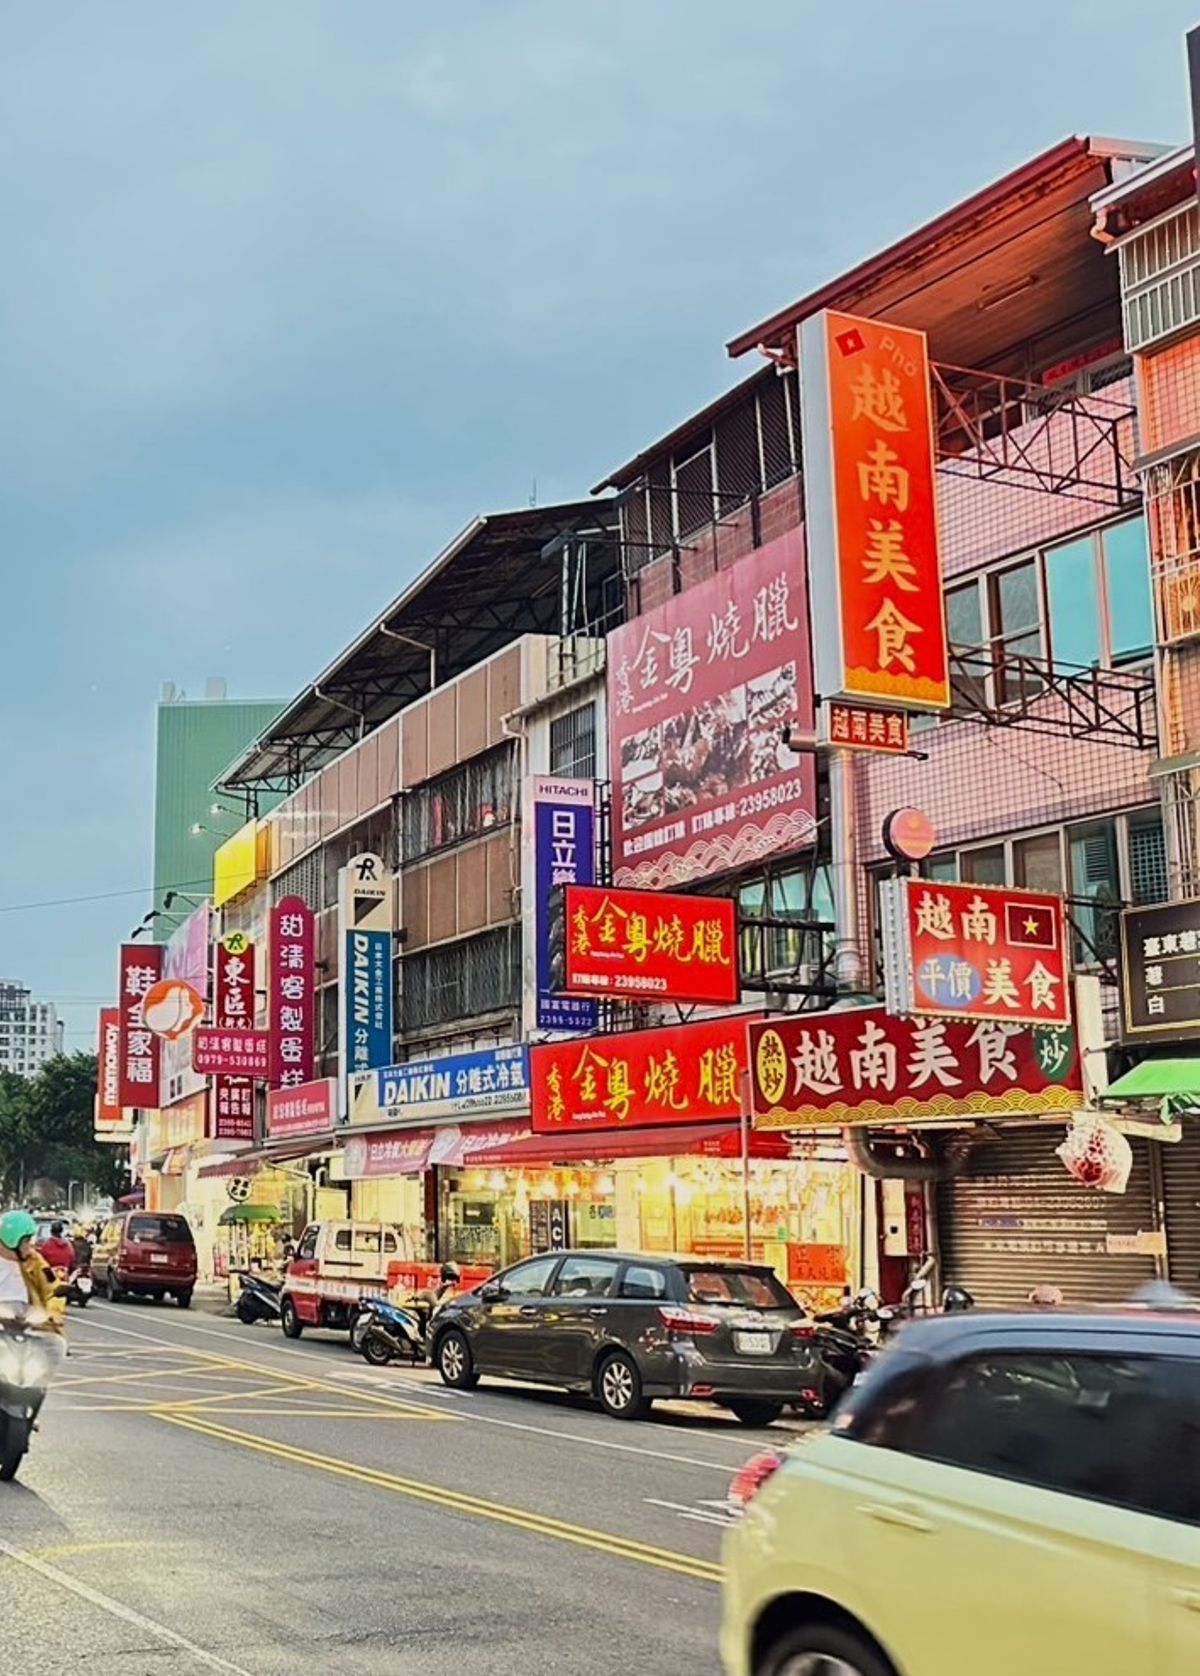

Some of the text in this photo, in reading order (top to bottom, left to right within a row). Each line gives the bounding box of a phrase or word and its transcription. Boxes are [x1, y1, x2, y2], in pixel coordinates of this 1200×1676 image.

[849, 361, 924, 673] 越南美食
[632, 571, 799, 693] 金粵燒臘
[832, 707, 904, 746] 越南美食
[538, 784, 588, 797] HITACHI
[353, 887, 386, 897] DAIKIN
[914, 890, 999, 946] 越南
[590, 895, 730, 965] 金粵燒臘
[223, 959, 251, 1016] 東區
[354, 932, 370, 1025] DAIKIN
[918, 958, 1062, 1012] 平價 美食
[570, 1043, 743, 1121] 金粵燒臘
[790, 1014, 1026, 1098] 越南美食
[384, 1070, 451, 1105] DAIKIN
